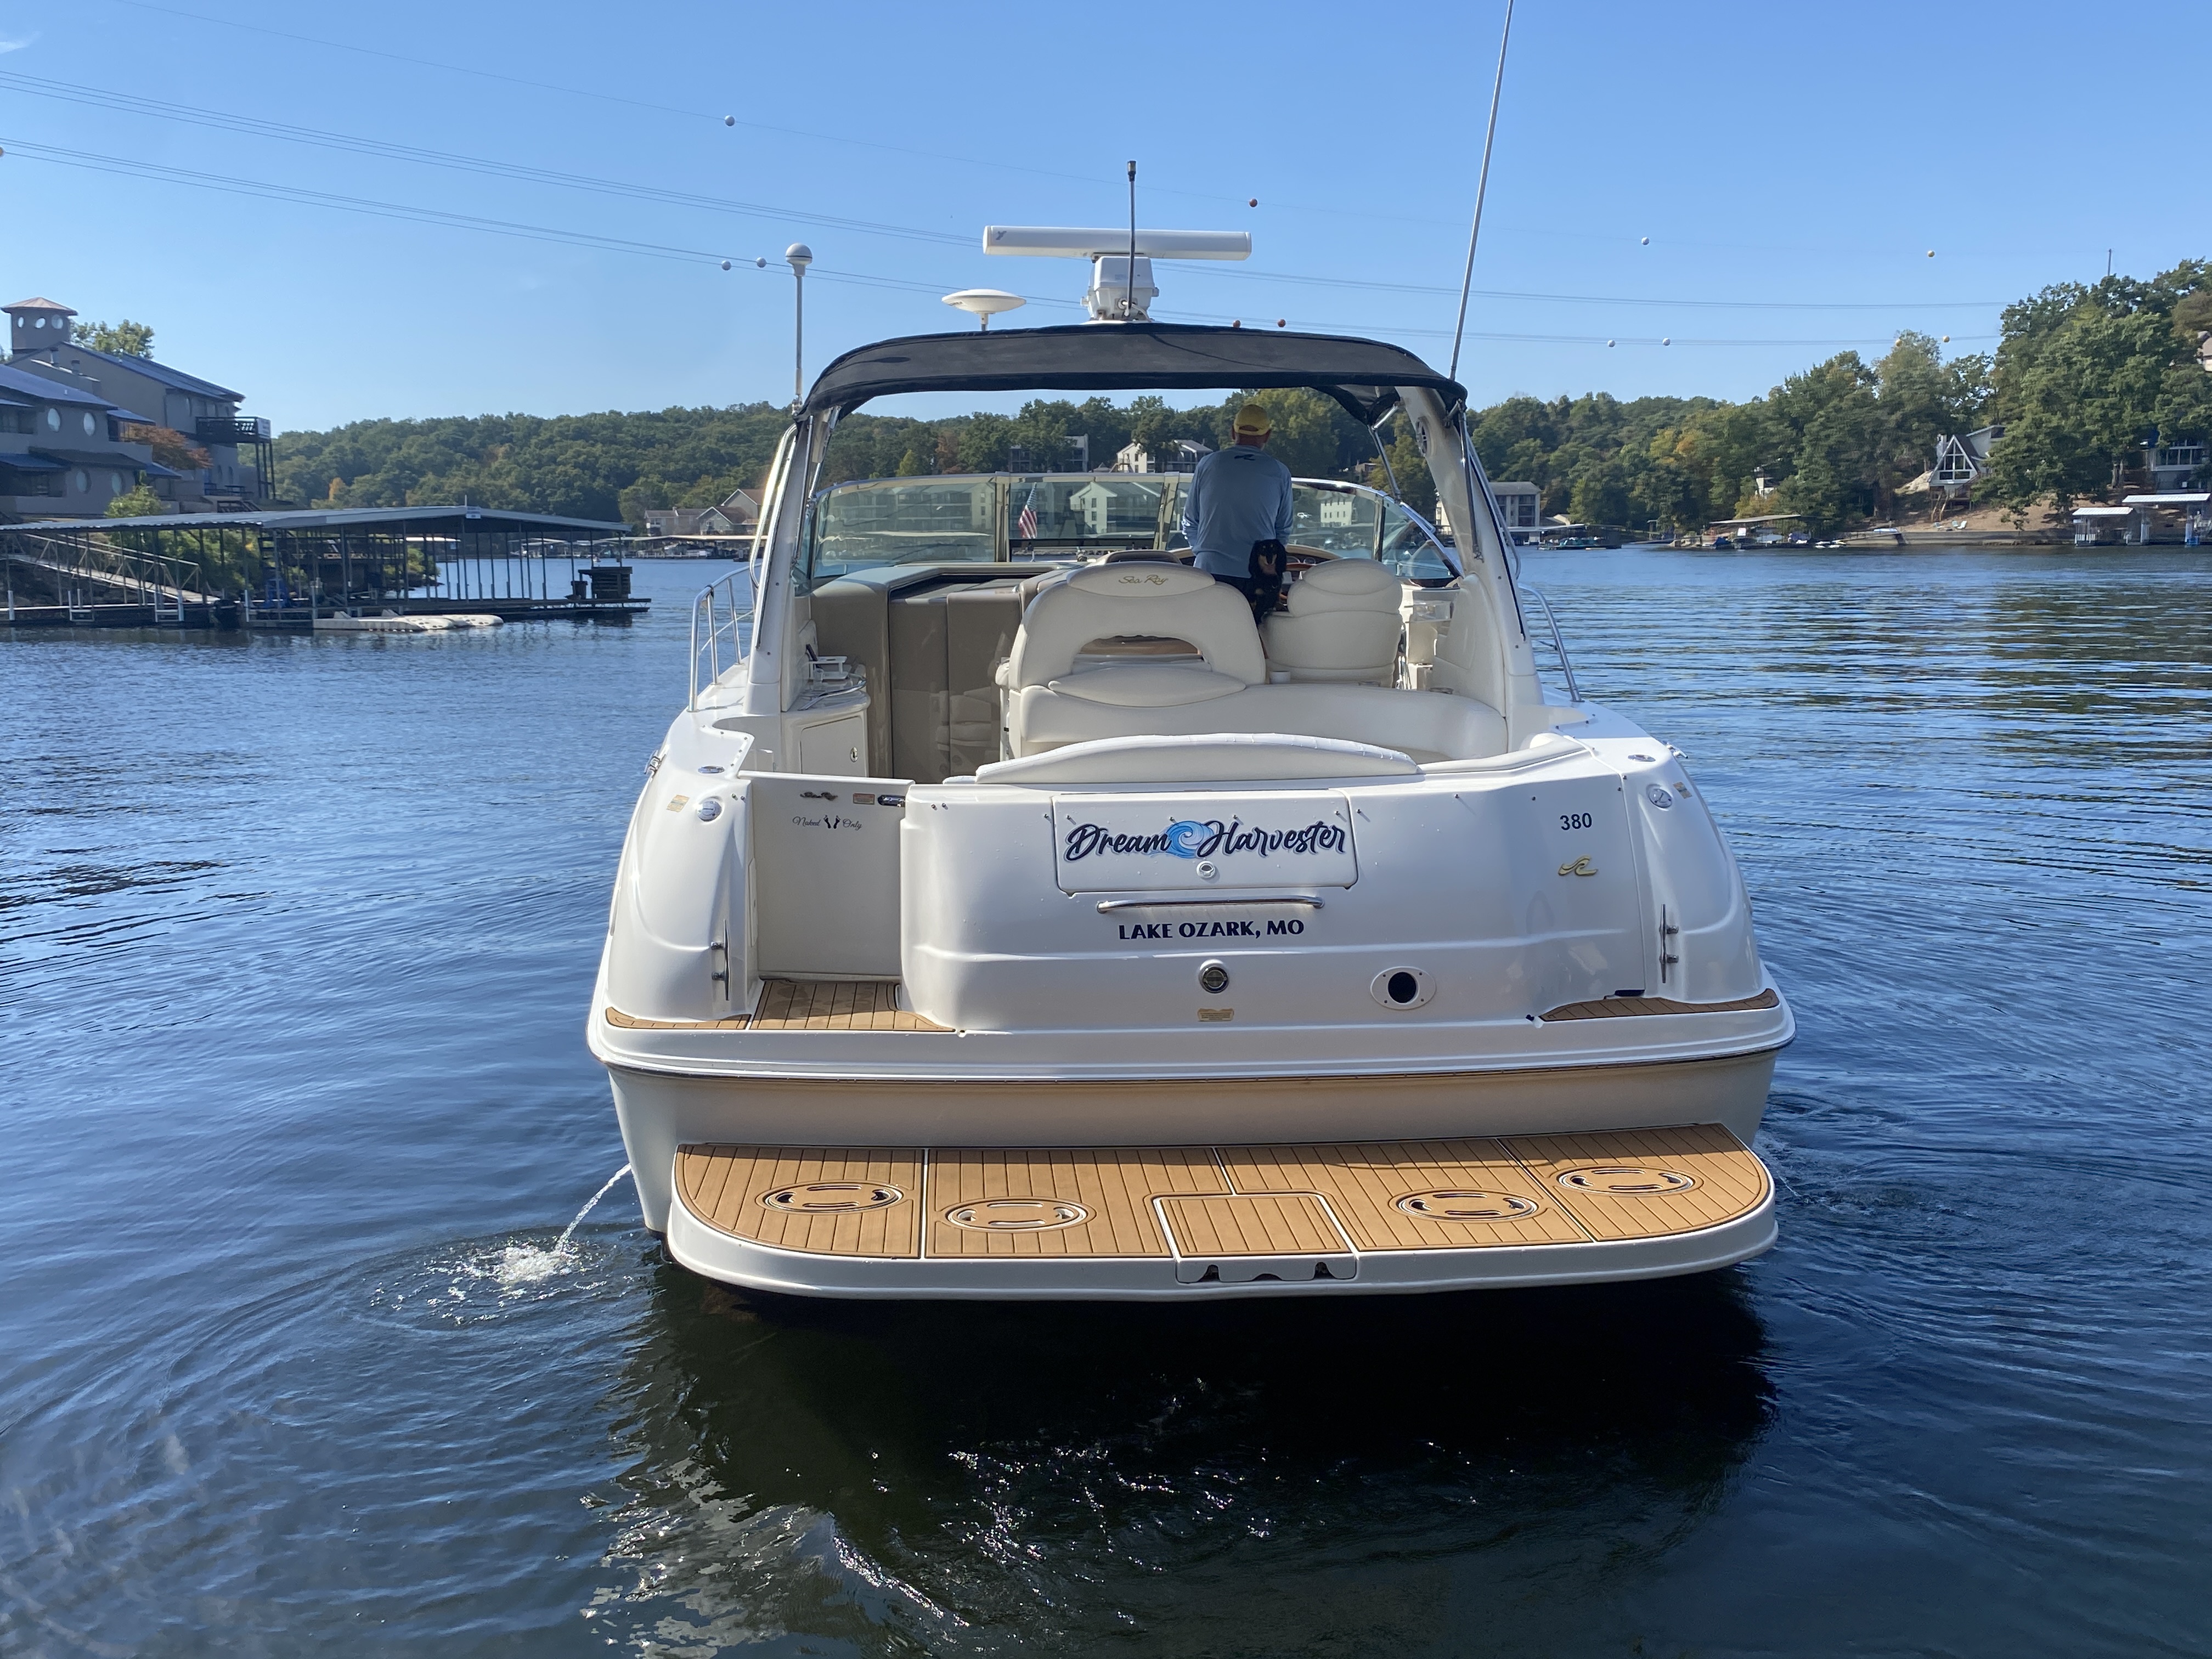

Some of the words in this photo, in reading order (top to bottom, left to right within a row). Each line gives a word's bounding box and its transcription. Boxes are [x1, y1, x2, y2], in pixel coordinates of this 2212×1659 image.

[1119, 575, 1142, 584] Sea
[1144, 574, 1169, 585] Ray
[842, 818, 862, 831] Only
[1560, 812, 1592, 831] 380
[1064, 823, 1172, 861] Dream
[1197, 821, 1345, 859] Harvester
[1119, 923, 1173, 939] LAKE
[1178, 921, 1261, 939] OZARK,
[1267, 919, 1304, 935] MO
